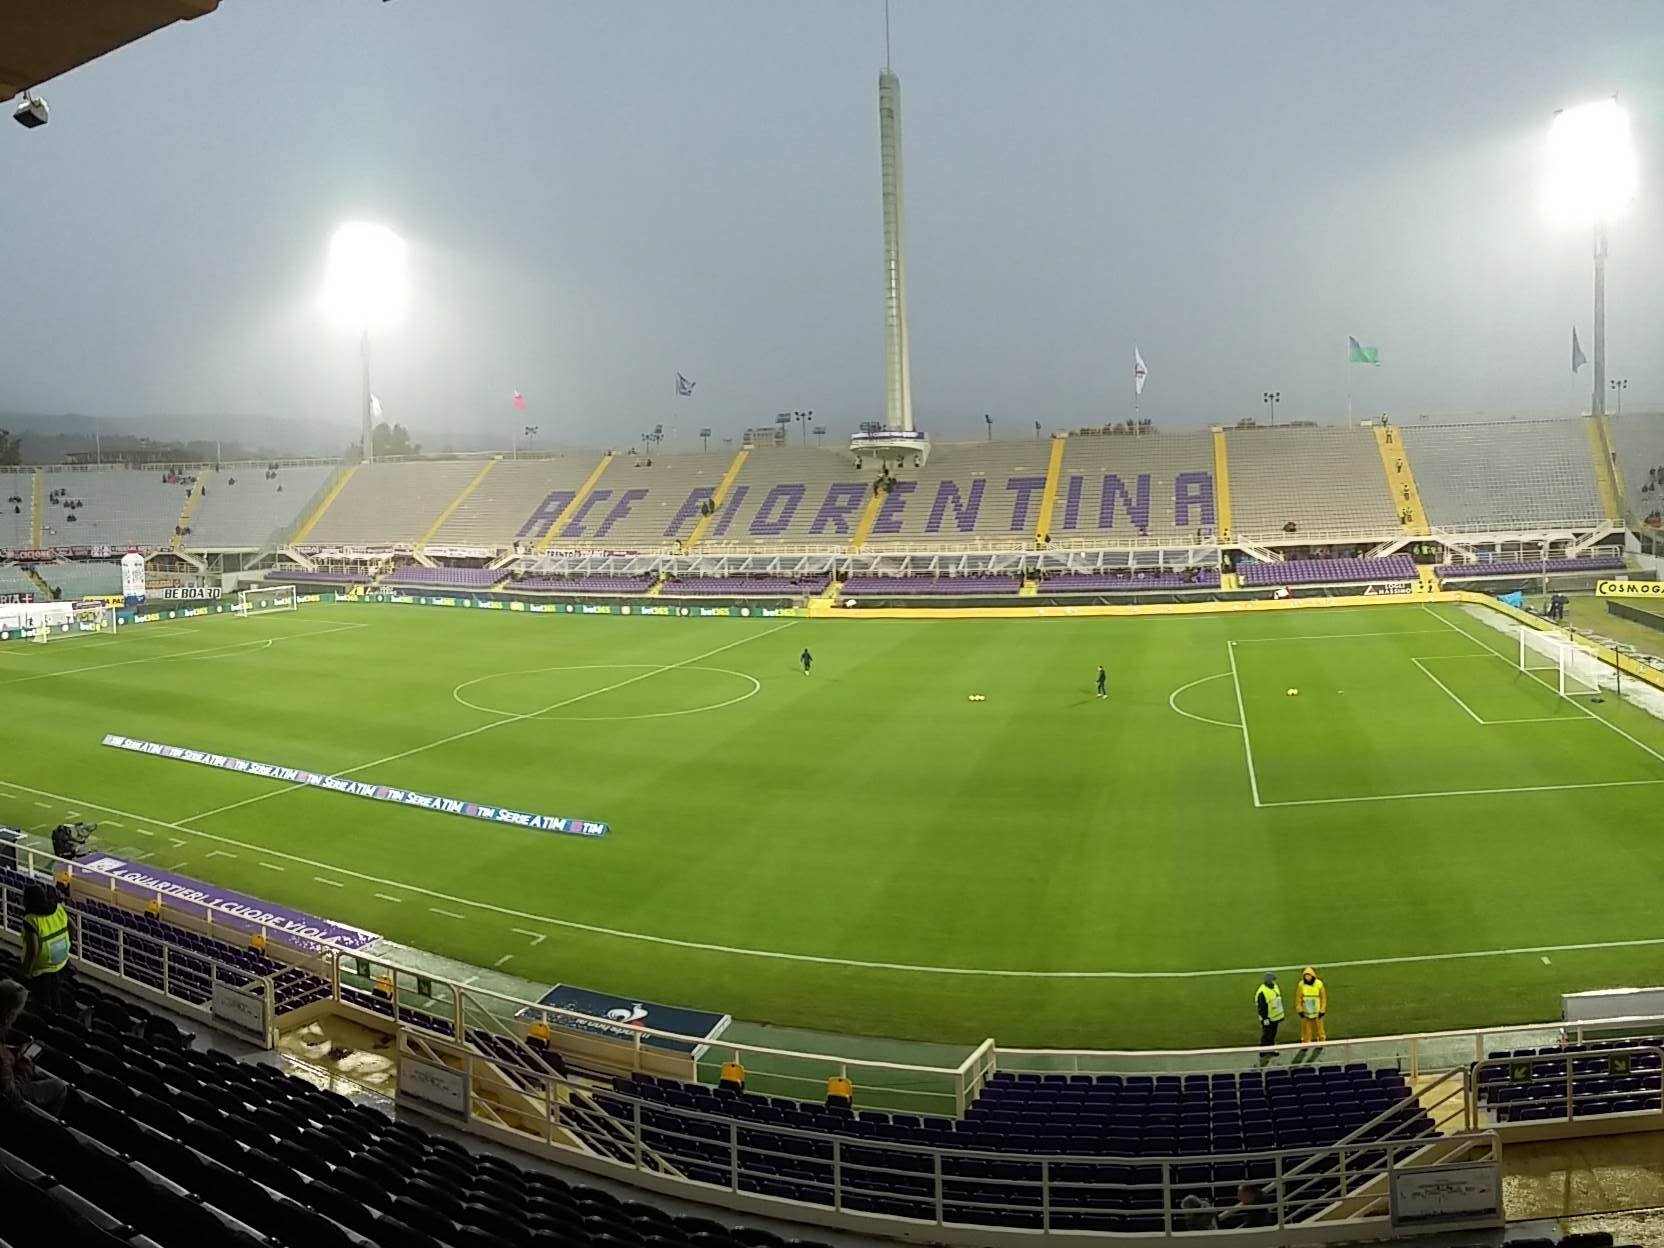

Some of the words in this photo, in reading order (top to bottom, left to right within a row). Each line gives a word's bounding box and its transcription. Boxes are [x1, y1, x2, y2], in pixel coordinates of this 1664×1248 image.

[515, 489, 649, 538] ACF
[663, 472, 1214, 537] FIORENTINA
[164, 588, 179, 599] BE
[583, 606, 610, 614] bet365
[641, 606, 669, 615] bet365
[701, 607, 729, 615] bet365
[762, 607, 796, 617] bet365
[281, 768, 298, 780] TIM
[345, 782, 356, 792] A
[356, 784, 377, 797] TIM
[431, 799, 442, 809] A
[441, 800, 464, 813] TIM
[477, 808, 495, 818] TIM
[495, 809, 531, 823] SERIE
[529, 816, 541, 828] A
[541, 817, 566, 831] TIM
[583, 823, 603, 834] TIM
[221, 902, 286, 926] CUORE
[283, 919, 341, 944] VIOLA
